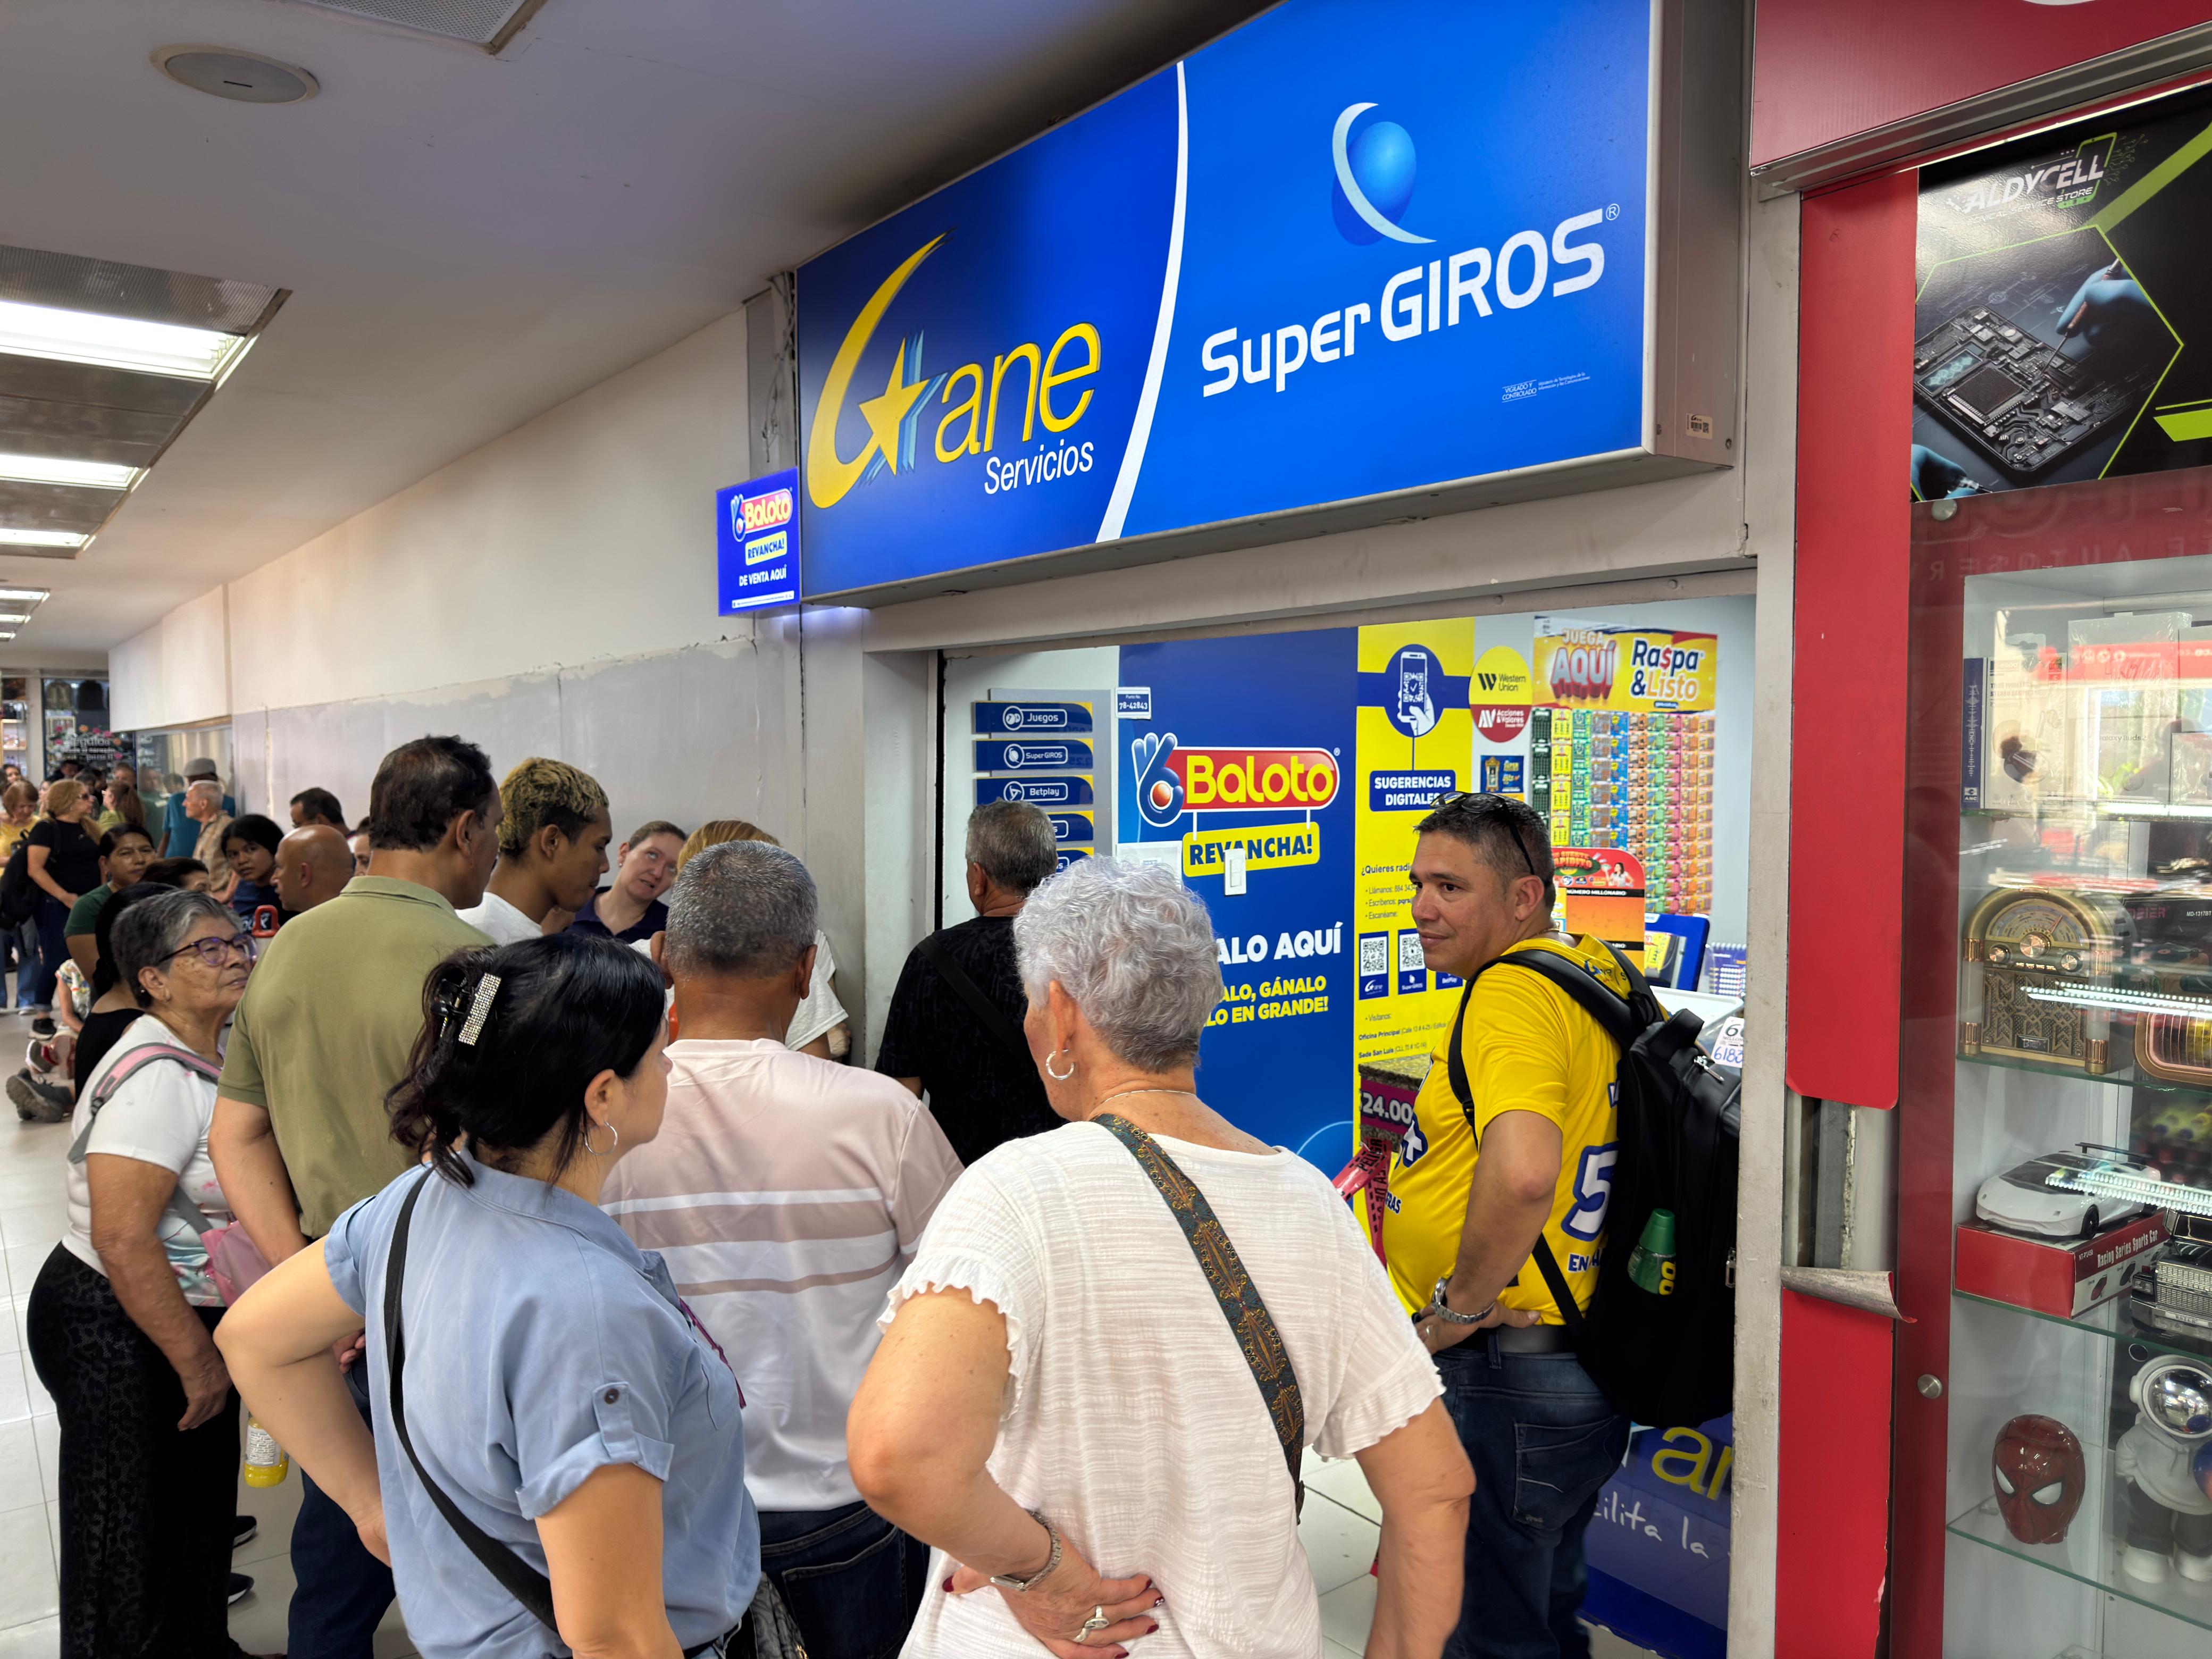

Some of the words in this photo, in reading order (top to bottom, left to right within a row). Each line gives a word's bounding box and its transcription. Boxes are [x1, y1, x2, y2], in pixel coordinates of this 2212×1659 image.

[2056, 187, 2093, 203] STORE
[807, 232, 1102, 509] Gane
[1502, 388, 1537, 400] CONTROLADO
[1505, 383, 1528, 393] VIGILADO
[984, 439, 1094, 495] Servicios
[745, 495, 791, 529] Baloto
[748, 538, 784, 559] REVANCHA!
[739, 574, 748, 586] DE
[749, 571, 769, 584] VENTA
[770, 564, 787, 581] AQUÍ
[1562, 629, 1605, 646] JUEGA
[1551, 640, 1617, 689] AQUÍ
[1498, 674, 1526, 682] Western
[1498, 683, 1518, 691] Union
[1119, 701, 1148, 710] 78-42843
[1027, 713, 1059, 723] Juegos
[1186, 755, 1334, 805] Baloto
[1374, 776, 1452, 789] SUGERENCIAS
[1029, 787, 1060, 797] Betplay
[1361, 864, 1394, 876] ¿Quieres
[1273, 921, 1344, 960] AQUÍ
[1259, 975, 1327, 998] GÁNALO
[1203, 1008, 1228, 1027] LO
[1232, 1005, 1254, 1024] EN
[1258, 996, 1329, 1020] GRANDE!
[1378, 1029, 1400, 1038] Principal
[2097, 1250, 2114, 1268] Racing
[2115, 1242, 2132, 1260] Series
[2132, 1233, 2148, 1252] Sports
[2149, 1229, 2158, 1243] Car
[1568, 1253, 1589, 1273] EN
[1593, 1490, 1663, 1541] ilita
[1682, 1516, 1710, 1559] la
